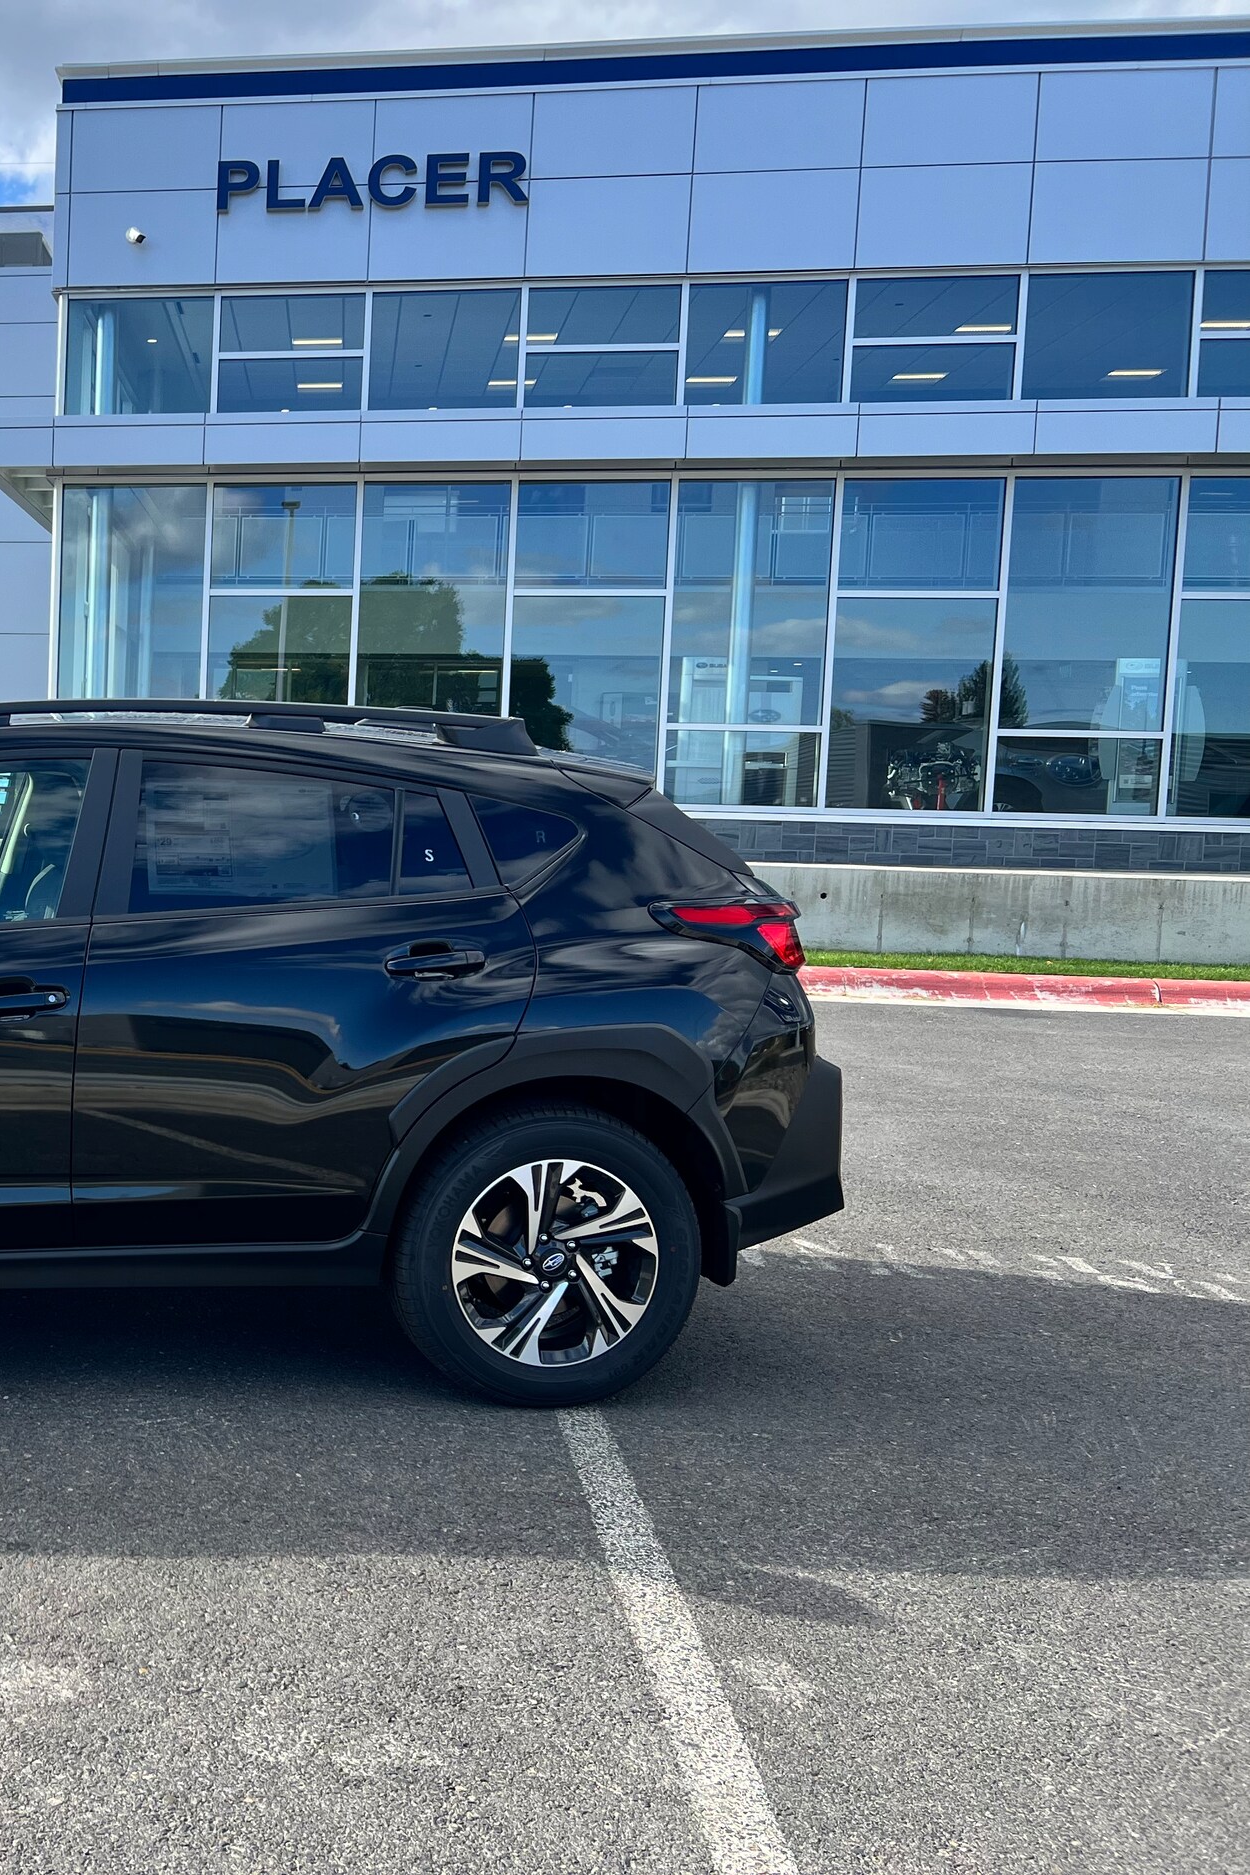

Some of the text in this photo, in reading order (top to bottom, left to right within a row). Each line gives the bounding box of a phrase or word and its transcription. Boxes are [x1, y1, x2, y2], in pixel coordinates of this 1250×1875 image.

[216, 151, 529, 213] PLACER
[424, 849, 435, 862] S
[535, 830, 547, 844] R
[427, 1160, 485, 1247] YOKOHAMA
